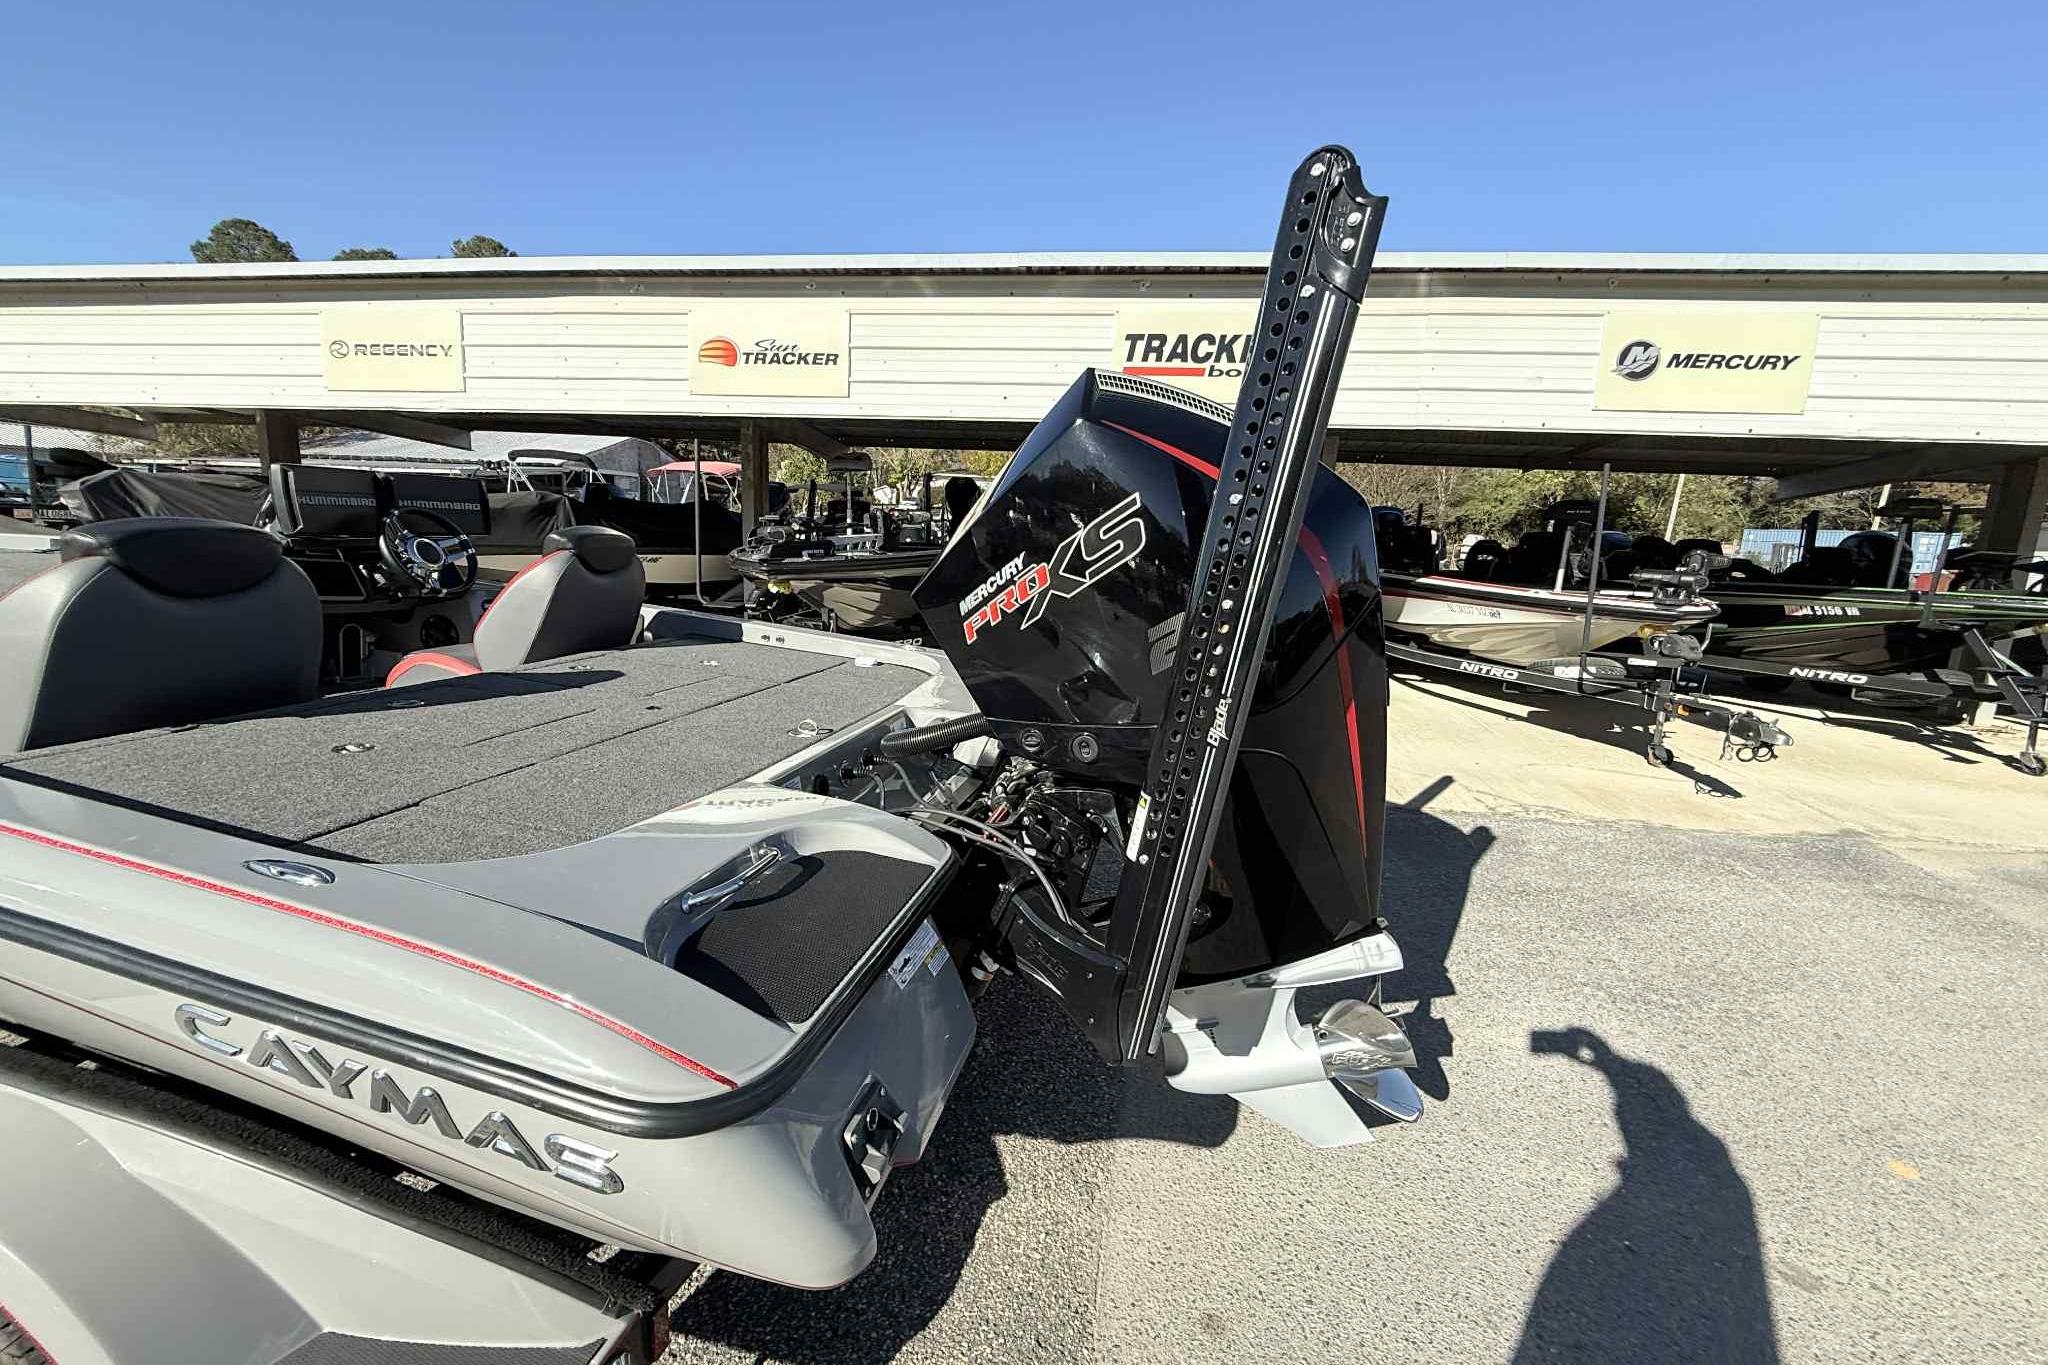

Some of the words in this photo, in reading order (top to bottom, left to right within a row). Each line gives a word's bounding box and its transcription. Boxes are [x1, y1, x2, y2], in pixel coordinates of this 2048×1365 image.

[354, 344, 453, 357] REGENCY
[755, 338, 800, 352] Sun
[742, 352, 840, 366] TRACKER
[1665, 353, 1802, 371] MERCURY
[1207, 365, 1243, 378] bo
[963, 562, 1051, 646] PRO
[1020, 491, 1146, 631] XS
[959, 551, 1026, 617] MERCURY
[1459, 660, 1520, 680] NITRO
[1788, 666, 1869, 684] NITRO
[174, 1003, 626, 1195] CAYMAS
